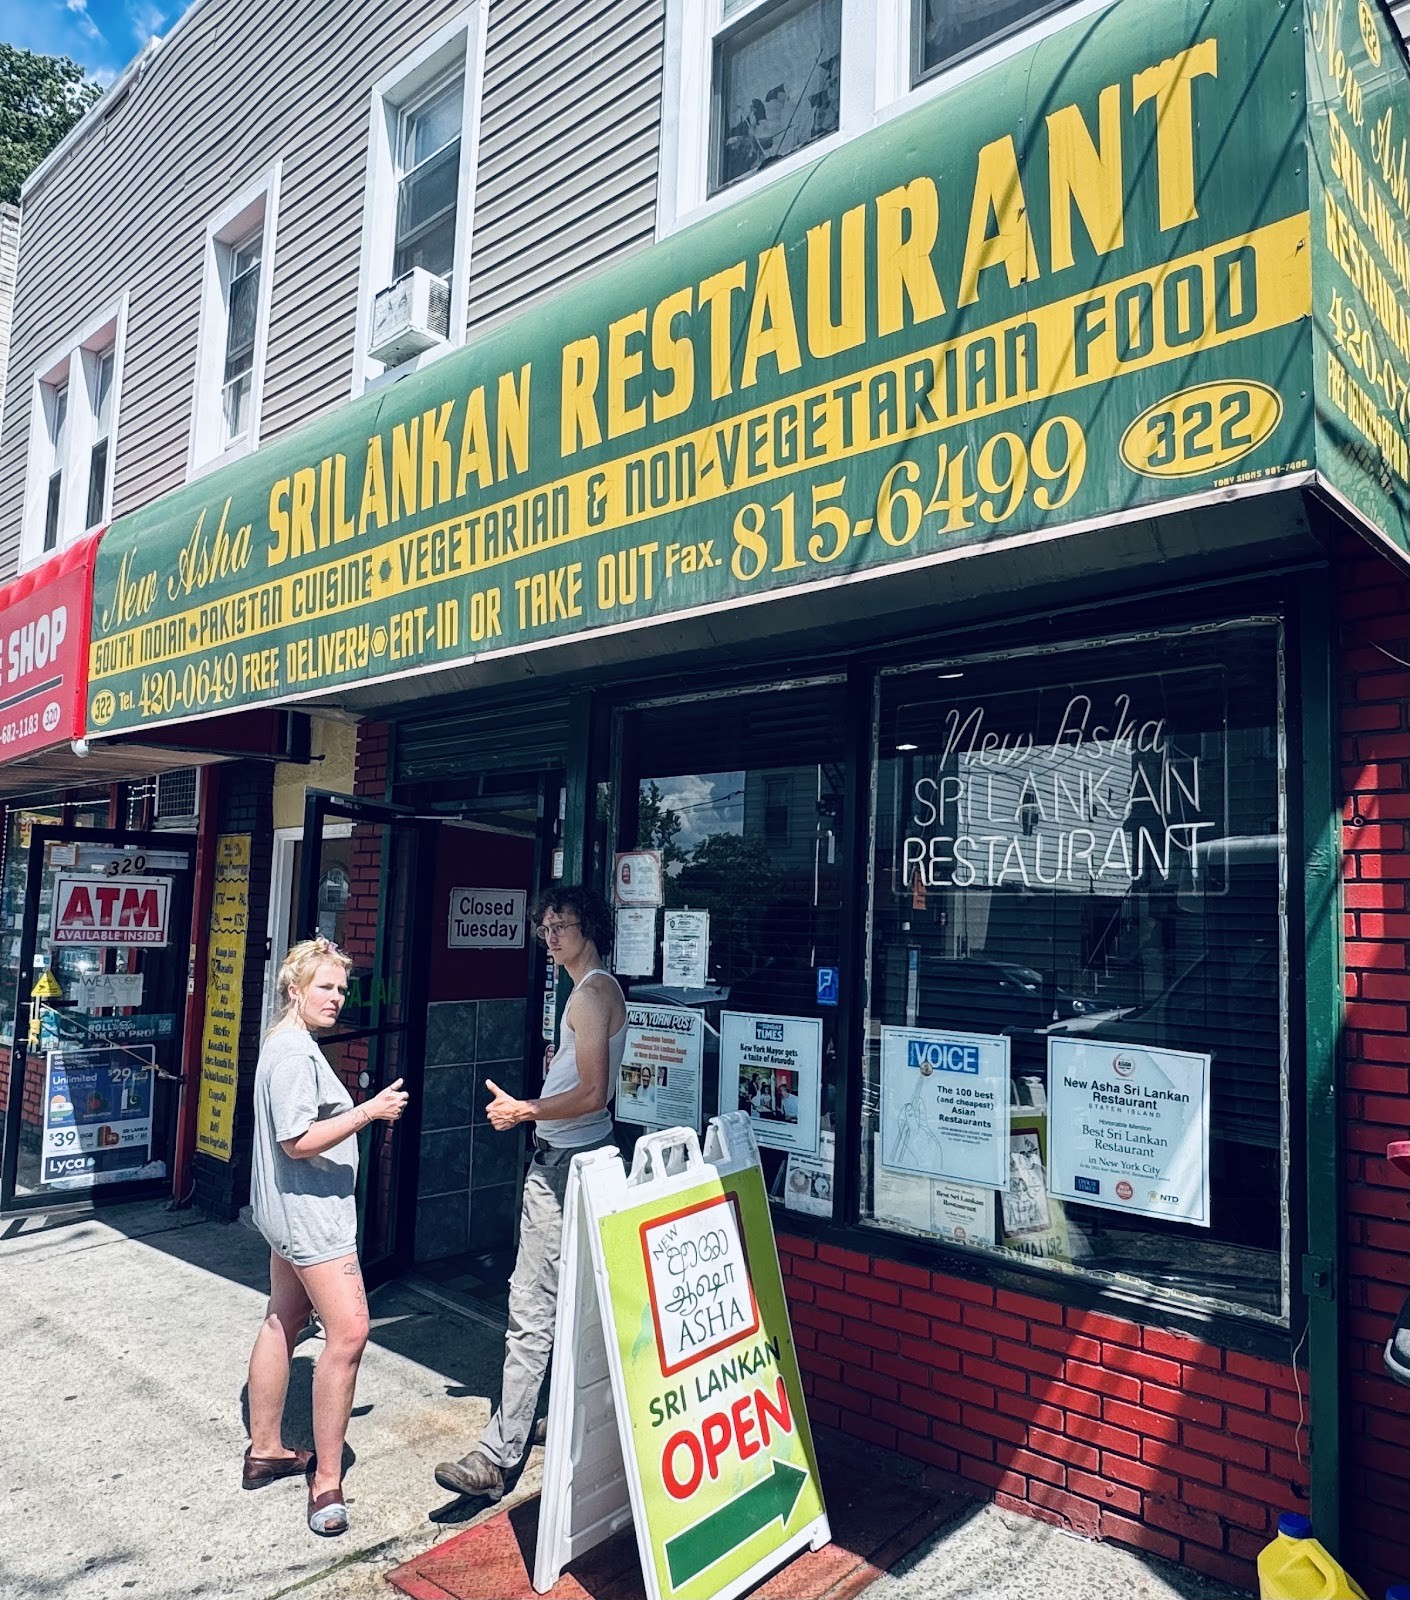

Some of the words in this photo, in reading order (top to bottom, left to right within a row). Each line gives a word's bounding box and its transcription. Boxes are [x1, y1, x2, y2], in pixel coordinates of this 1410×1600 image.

[1362, 7, 1378, 59] 322
[1313, 0, 1364, 126] New
[103, 547, 158, 631] New
[168, 494, 252, 600] Asha
[561, 38, 1218, 457] RESTAURANT
[1328, 286, 1410, 425] 420-07
[1146, 391, 1251, 468] 322
[94, 637, 133, 676] SOUTH
[140, 616, 187, 660] INDIAN
[200, 586, 282, 646] PAKISTAN
[291, 555, 373, 617] CUISINE
[399, 480, 570, 586] VEGETARIAN
[587, 472, 608, 527] &
[625, 321, 1038, 517] NON-VEGETARIAN
[1073, 245, 1257, 377] FOOD
[1213, 476, 1235, 488] TONY
[1236, 470, 1262, 482] SIGNS
[95, 696, 111, 719] 322
[119, 691, 135, 711] Tel.
[138, 652, 238, 717] 420-0649
[243, 647, 279, 694] FREE
[287, 623, 370, 684] DELIVERY
[390, 599, 458, 659] EAT-IN
[471, 582, 502, 641] OR
[515, 563, 582, 631] TAKE
[598, 542, 658, 610] OUT
[666, 540, 721, 578] Fax.
[731, 415, 1087, 580] 815-6499
[8, 605, 67, 683] SHOP
[45, 706, 58, 727] 320
[939, 707, 1033, 771] New
[1048, 693, 1168, 761] Asha
[903, 821, 1215, 887] RESTAURANT
[108, 855, 146, 877] 320
[60, 886, 159, 928] ATM
[459, 896, 514, 916] Closed
[57, 930, 121, 941] AVAILABLE
[123, 931, 162, 942] INSIDE
[454, 919, 518, 941] Tuesday
[88, 1023, 113, 1032] ROLL
[628, 1010, 648, 1026] NEW
[648, 1012, 672, 1029] YORK
[671, 1015, 695, 1032] POST
[756, 1029, 783, 1040] TIMES
[740, 1043, 752, 1052] New
[753, 1045, 765, 1054] York
[766, 1046, 784, 1057] Mayor
[785, 1048, 798, 1058] gets
[748, 1054, 762, 1062] taste
[764, 1055, 770, 1063] of
[914, 1043, 976, 1072] VOICE
[52, 1073, 98, 1085] Unlimited
[108, 1067, 131, 1083] $29
[937, 1085, 953, 1094] The
[956, 1088, 972, 1097] 100
[974, 1090, 994, 1099] best
[1064, 1077, 1087, 1090] New
[1091, 1080, 1120, 1094] Asha
[1124, 1084, 1140, 1096] Sri
[1144, 1086, 1190, 1103] Lankan
[1093, 1092, 1158, 1110] Restaurant
[937, 1095, 954, 1104] (and
[956, 1099, 994, 1111] cheapest)
[952, 1106, 976, 1117] Asian
[1089, 1103, 1122, 1113] STATEN
[1127, 1109, 1161, 1118] ISLAND
[939, 1113, 991, 1128] Restaurants
[49, 1131, 76, 1147] $39
[1082, 1124, 1104, 1137] Best
[1107, 1128, 1122, 1140] Sri
[1125, 1131, 1168, 1147] Lankan
[1094, 1138, 1154, 1157] Restaurant
[50, 1158, 85, 1174] Lyca
[1088, 1156, 1096, 1164] in
[1099, 1157, 1118, 1168] New
[1121, 1160, 1140, 1171] York
[1142, 1164, 1161, 1177] City
[1160, 1194, 1179, 1203] NTD
[652, 1224, 678, 1261] NEW
[678, 1296, 745, 1352] ASHA
[649, 1385, 687, 1428] SRI
[695, 1336, 782, 1403] LANKAN
[662, 1377, 793, 1500] OPEN
